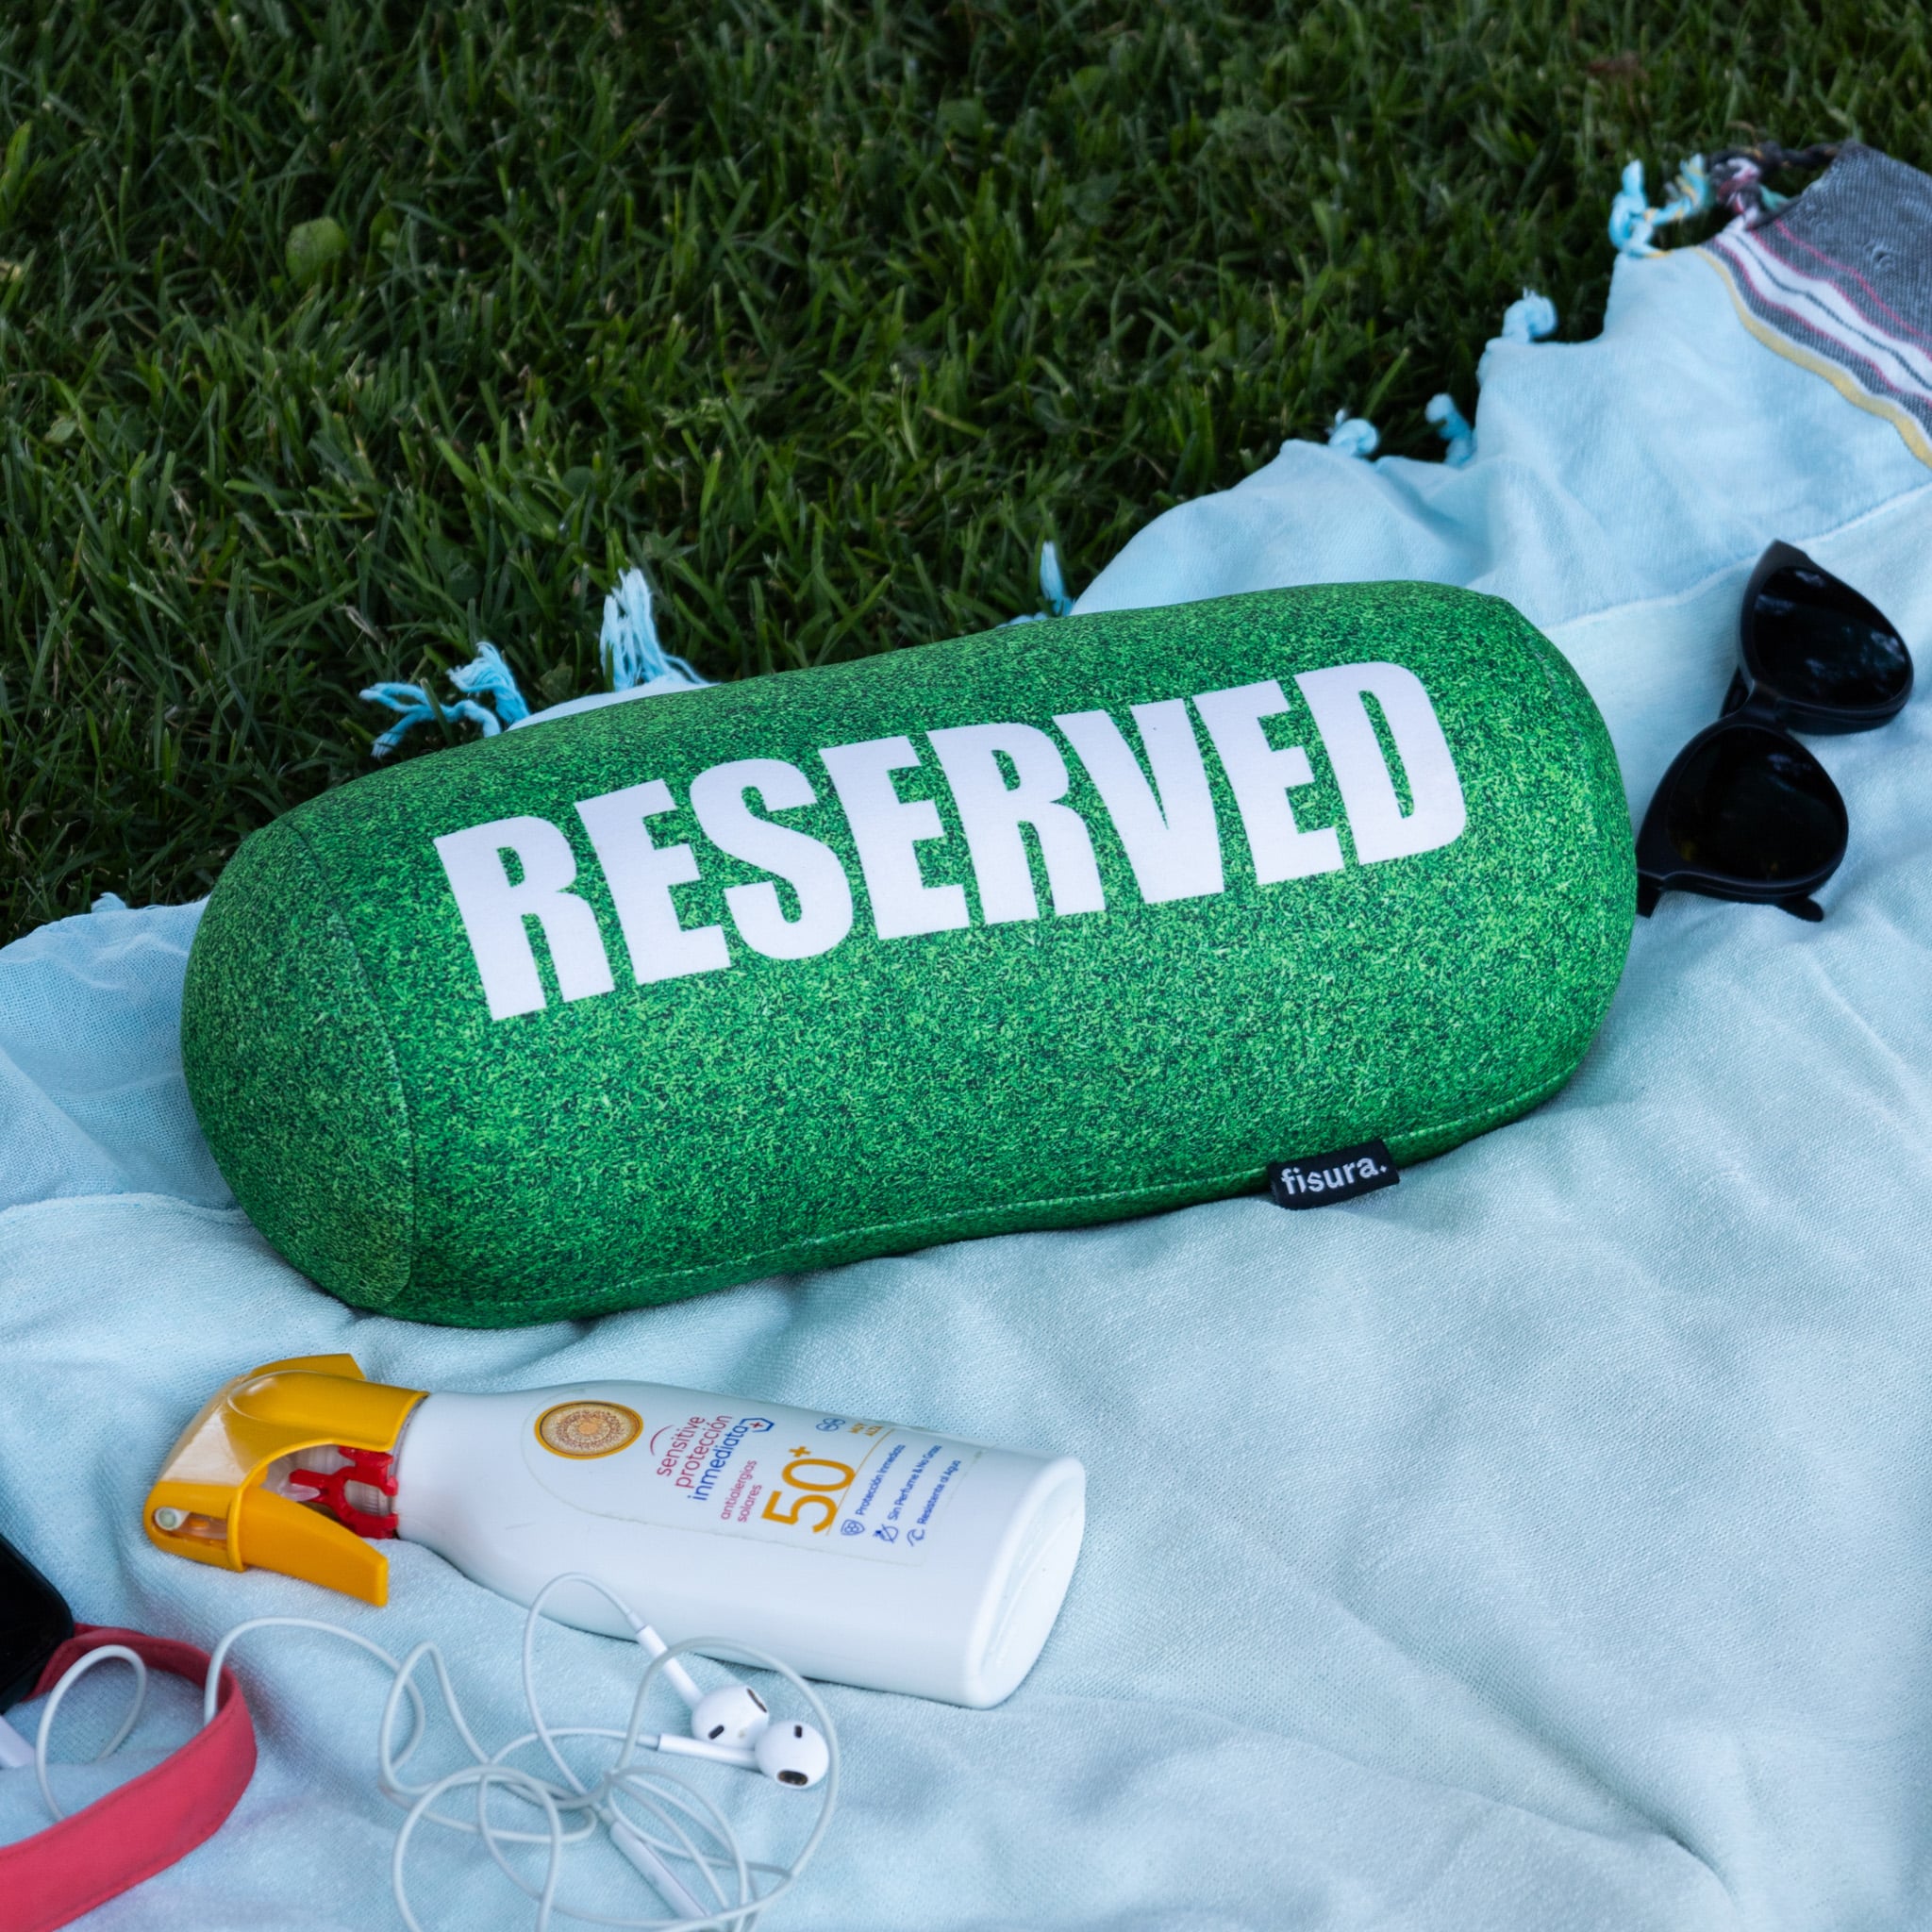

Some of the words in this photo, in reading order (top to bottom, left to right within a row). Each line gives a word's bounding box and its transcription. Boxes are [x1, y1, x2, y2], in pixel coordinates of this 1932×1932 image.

[434, 661, 1468, 1022] RESERVED
[1281, 1158, 1388, 1195] fisura.
[657, 1416, 706, 1476] sensitive
[675, 1415, 733, 1489] protección
[687, 1424, 749, 1500] inmediata
[721, 1460, 758, 1520] antialergias
[738, 1484, 762, 1523] solares
[855, 1474, 885, 1515] Protección
[887, 1507, 903, 1521] Sin
[894, 1474, 921, 1506] Perfume
[916, 1484, 945, 1524] Resistente
[943, 1459, 961, 1476] Agua
